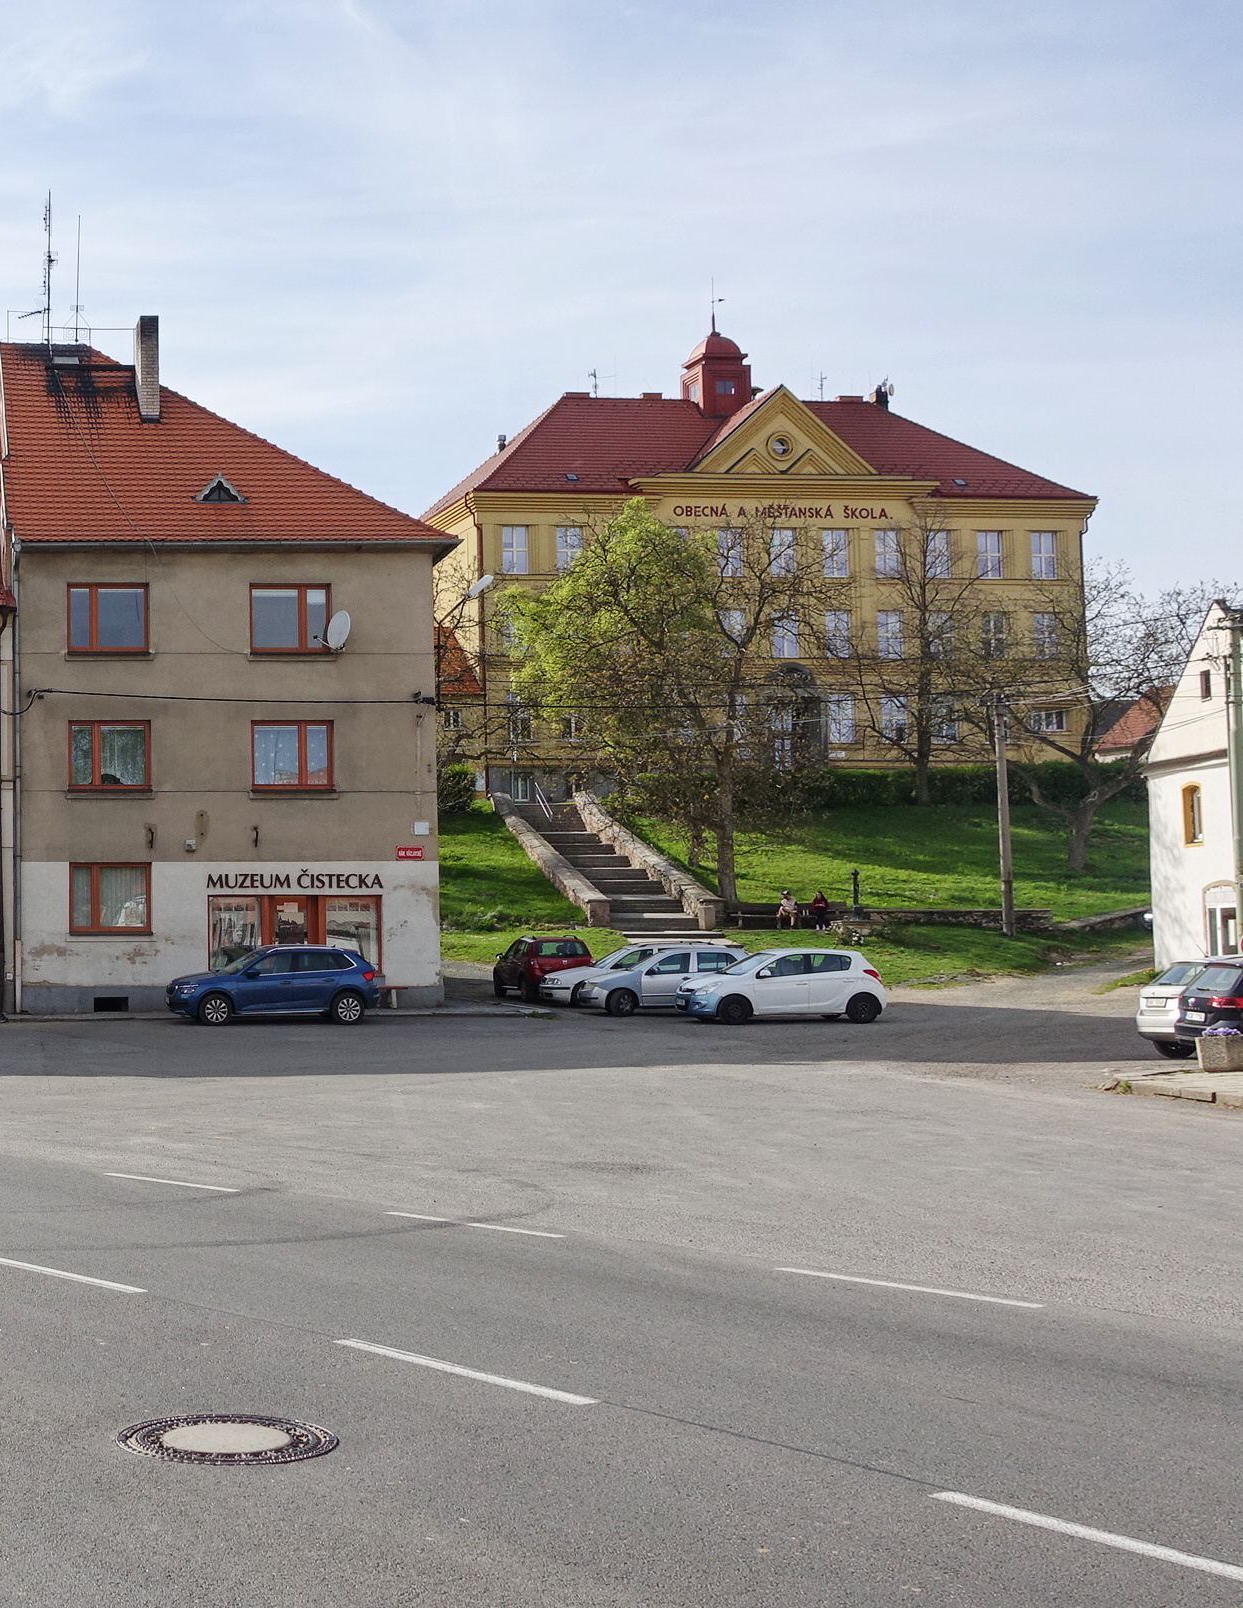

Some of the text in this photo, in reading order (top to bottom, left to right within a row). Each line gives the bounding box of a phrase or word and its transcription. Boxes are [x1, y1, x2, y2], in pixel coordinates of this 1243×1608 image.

[673, 502, 728, 517] OBECNÁ
[737, 506, 747, 518] A
[206, 868, 384, 889] MUZEUM ČISTECKA
